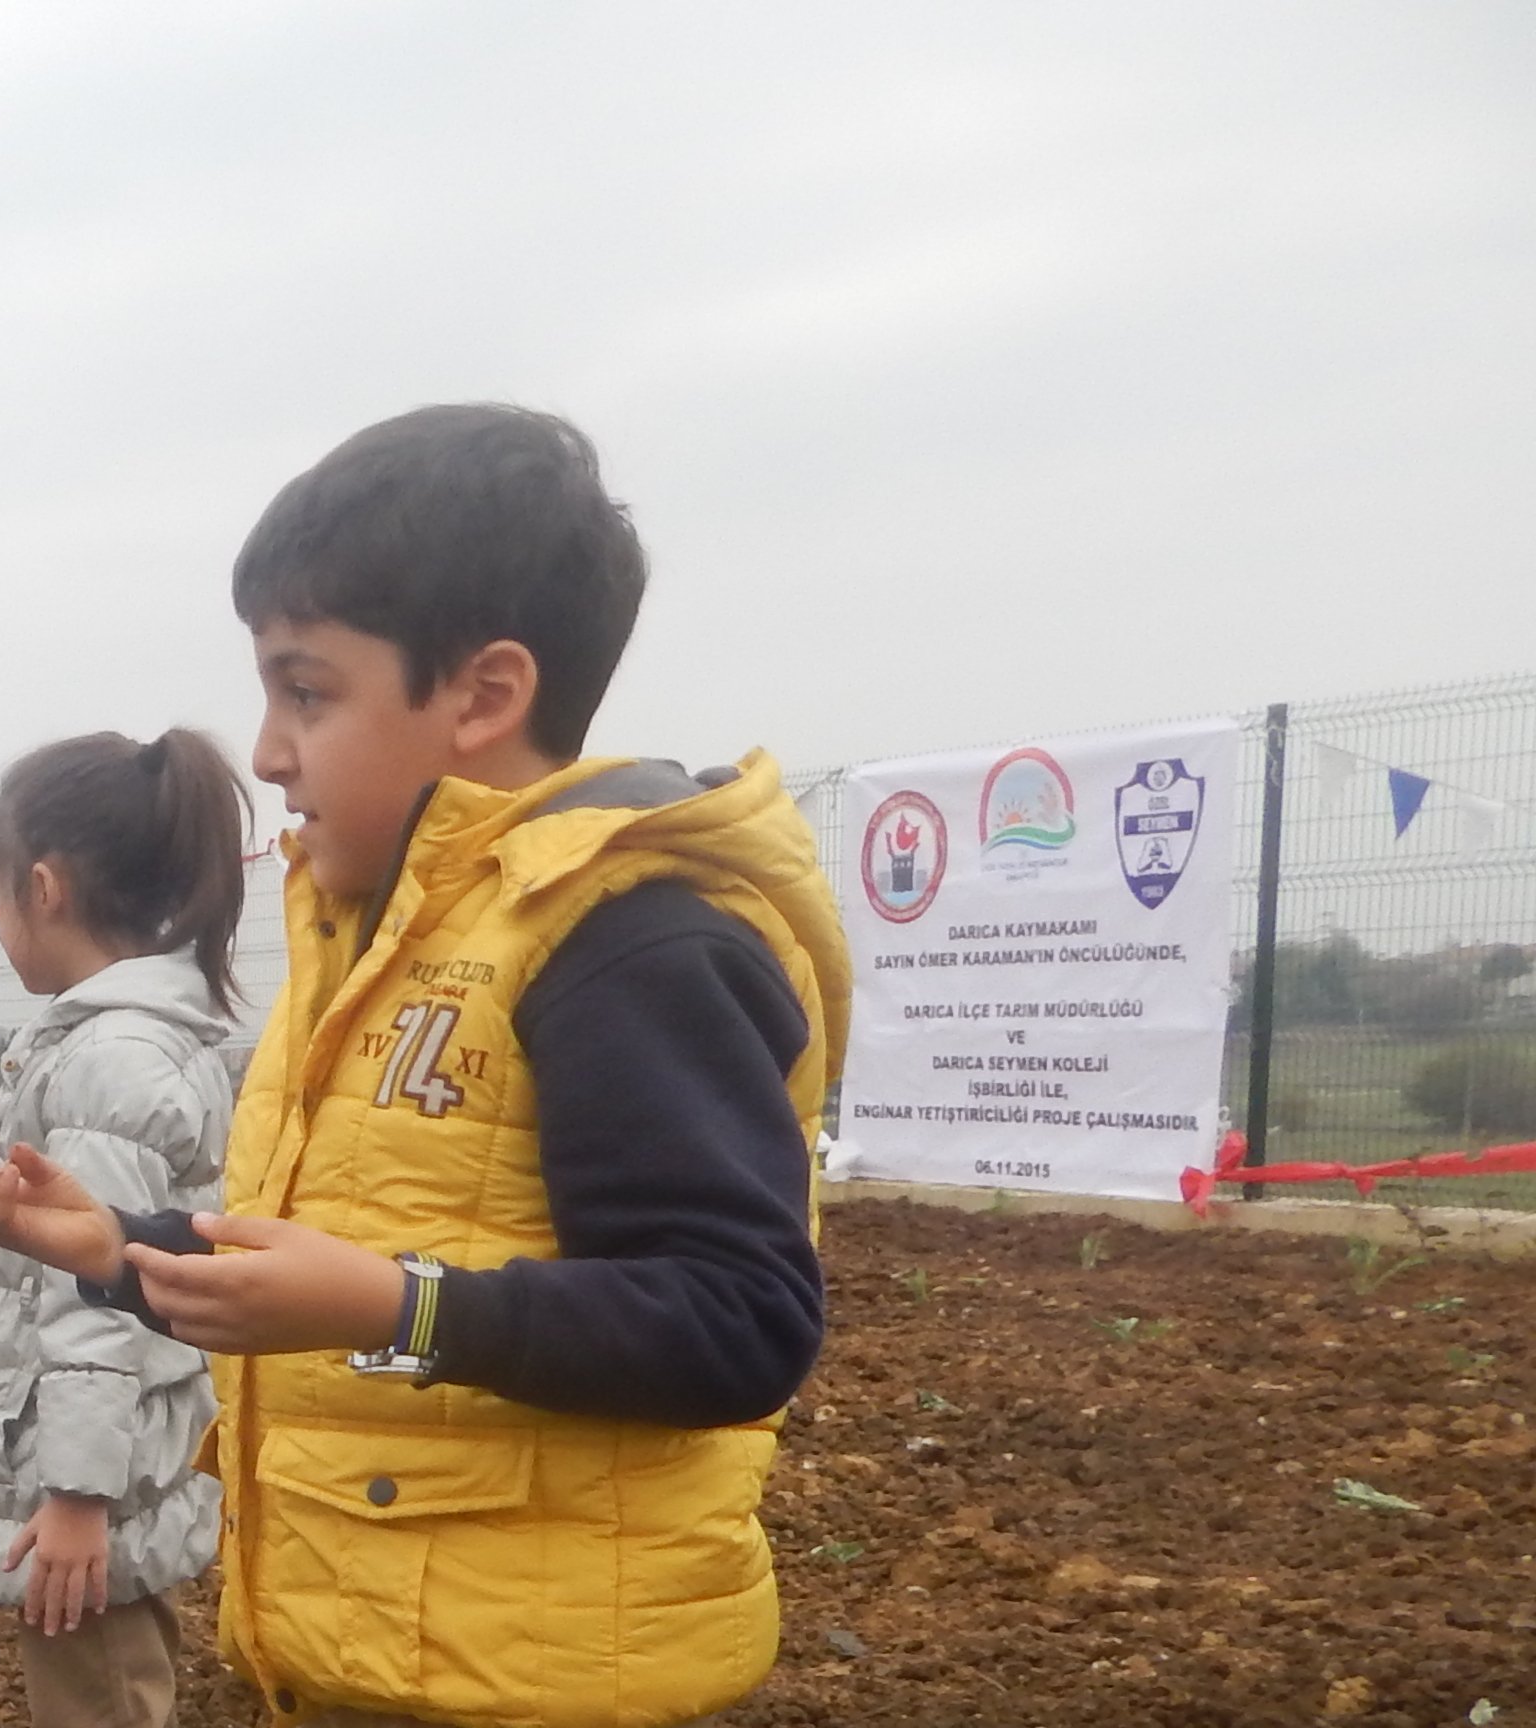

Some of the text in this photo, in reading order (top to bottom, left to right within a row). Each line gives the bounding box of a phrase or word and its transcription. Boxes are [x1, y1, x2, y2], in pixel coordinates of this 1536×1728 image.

[948, 919, 1097, 940] DARICA KAYMAKAMI
[874, 943, 1186, 969] SAYIN ÖMER KARAMAN'IN ÖNCÜLÜĞÜNDE,
[448, 959, 496, 985] CLUB
[904, 999, 1143, 1019] DARICA İLÇE TARIM MÜDÜRLÜĞÜ
[1007, 1030, 1025, 1044] VE
[357, 999, 489, 1119] XV 14 XI
[932, 1053, 1109, 1073] DARICA SEYMEN KOLEJİ
[967, 1078, 1068, 1100] İŞBİRLİĞİ İLE,
[854, 1102, 913, 1119] ENGİNAR
[917, 1103, 1028, 1124] YETİŞTİRİCİLİĞİ
[1032, 1109, 1082, 1127] PROJE
[974, 1158, 1051, 1178] 06.11.2015
